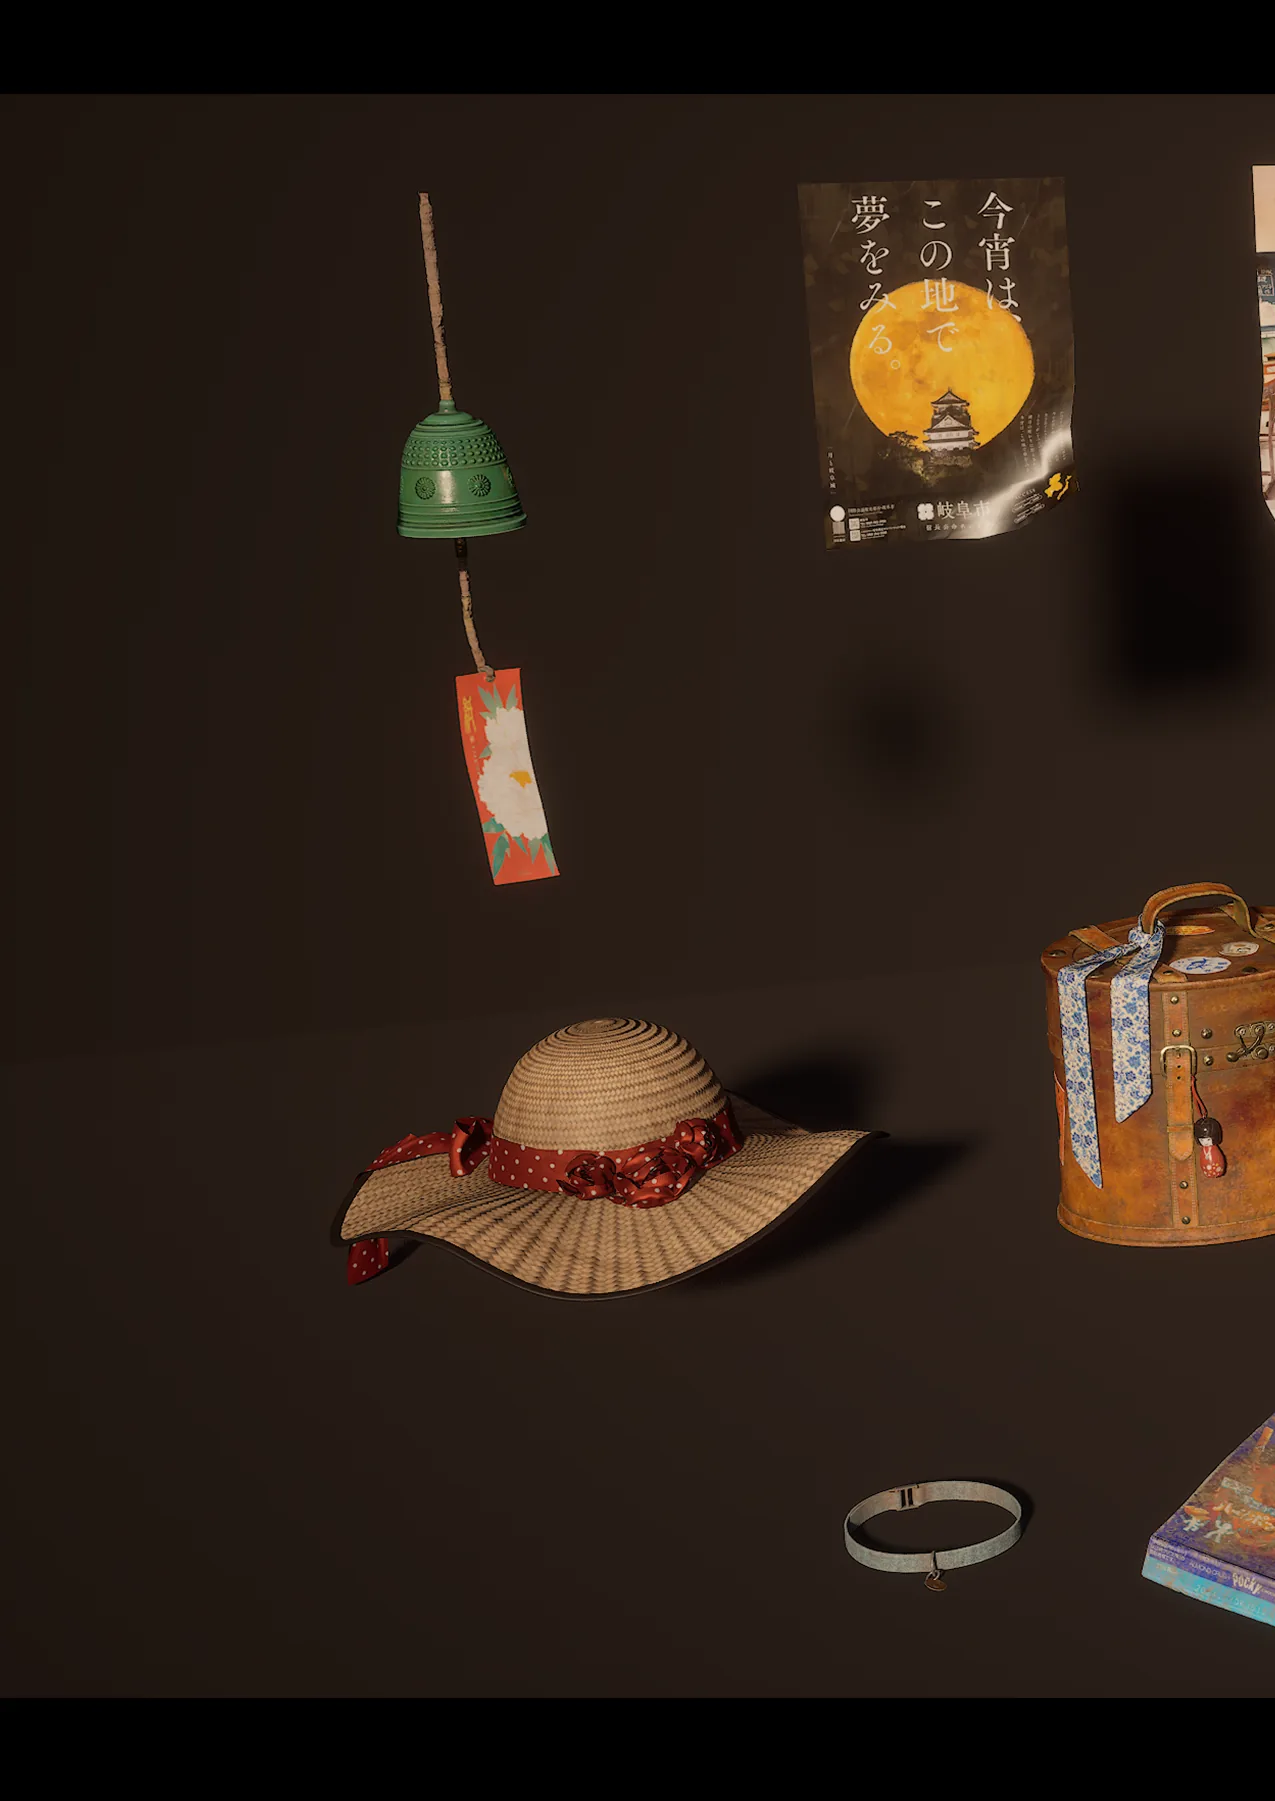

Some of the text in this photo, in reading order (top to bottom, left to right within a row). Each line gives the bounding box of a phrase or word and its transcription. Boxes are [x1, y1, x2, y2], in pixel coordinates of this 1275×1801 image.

[851, 195, 901, 370] 夢をみる。
[920, 199, 960, 352] この地で
[977, 191, 1022, 322] 今宵は、
